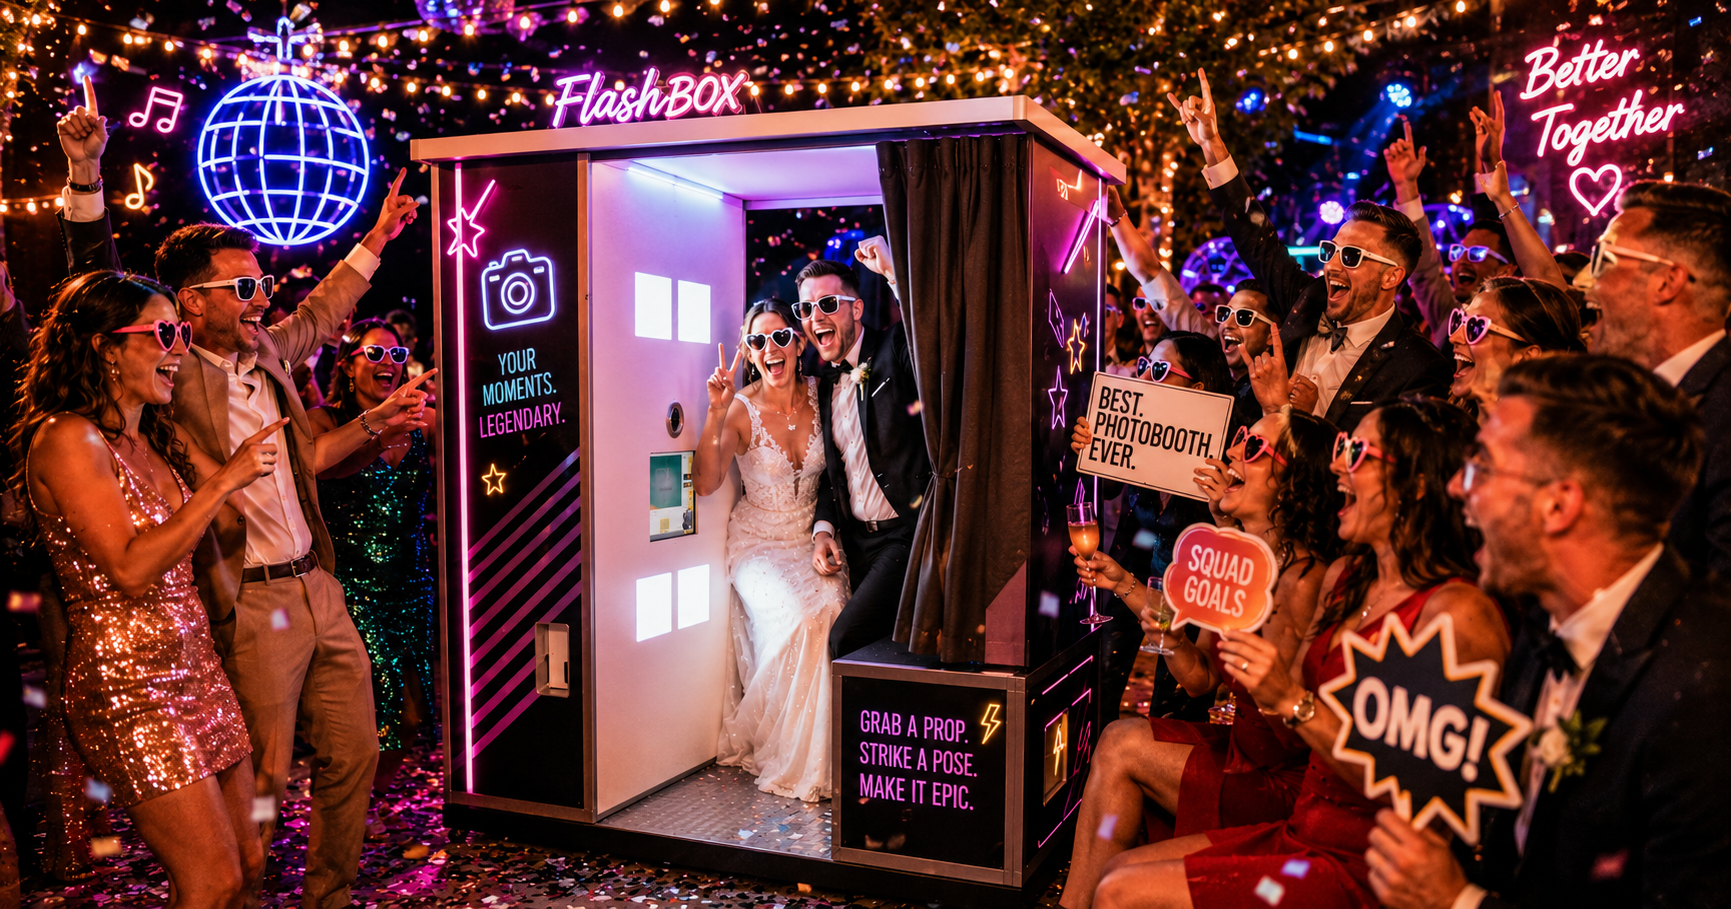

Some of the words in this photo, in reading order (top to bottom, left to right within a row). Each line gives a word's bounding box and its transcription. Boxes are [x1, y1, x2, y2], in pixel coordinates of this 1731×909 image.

[1519, 39, 1640, 100] Better
[552, 67, 748, 128] FlashBOX
[1530, 89, 1685, 166] Together
[497, 347, 537, 376] YOUR
[482, 371, 557, 407] MOMENTS.
[1098, 386, 1144, 417] BEST.
[479, 401, 566, 439] LEGENDARY.
[1093, 411, 1214, 459] PHOTOBOOTH.
[1088, 437, 1136, 470] EVER.
[1187, 544, 1254, 586] SQUAD
[1183, 575, 1247, 618] GOALS
[860, 709, 902, 736] GRAB
[906, 714, 918, 738] A
[923, 716, 969, 744] PROP.
[1352, 676, 1490, 783] OMG!
[859, 741, 913, 770] STRIKE
[916, 747, 928, 772] A
[932, 749, 978, 778] POSE.
[859, 773, 906, 802] MAKE
[911, 779, 927, 805] IT
[932, 781, 974, 811] EPIC.
